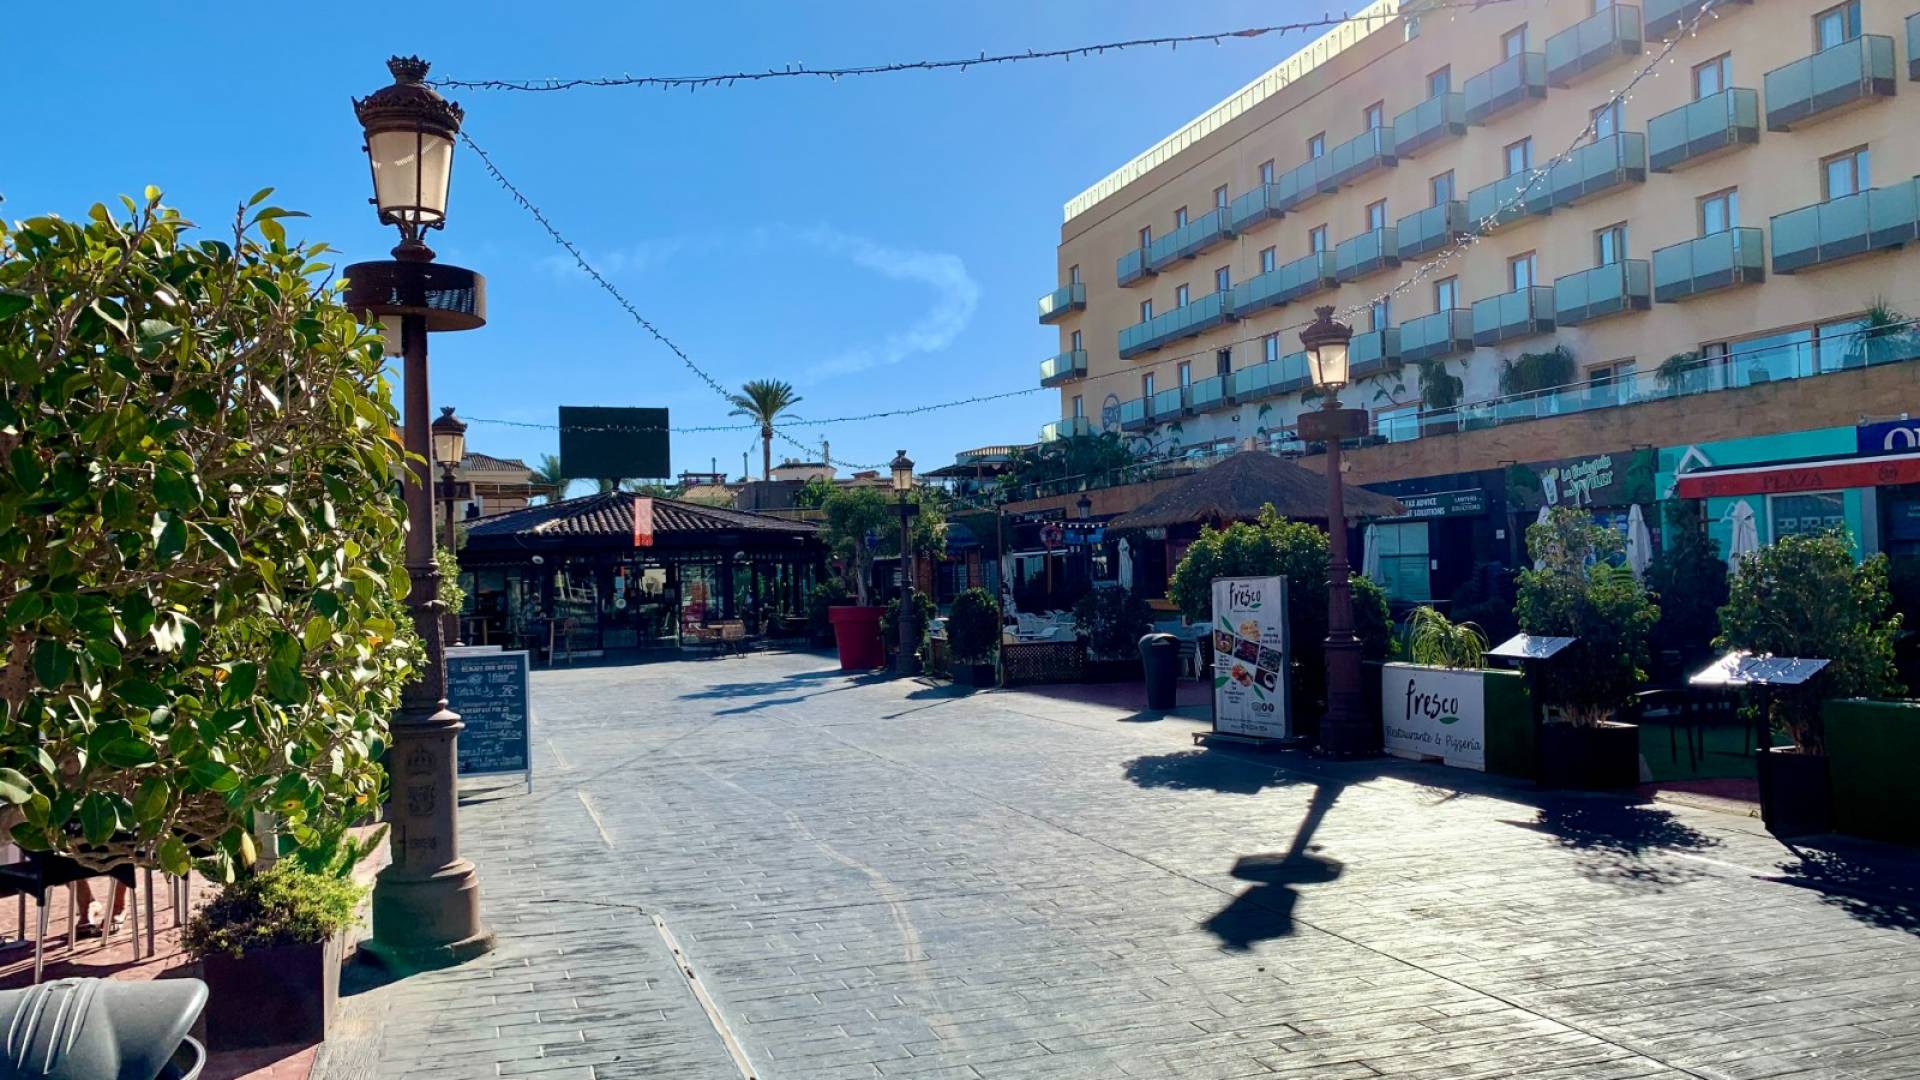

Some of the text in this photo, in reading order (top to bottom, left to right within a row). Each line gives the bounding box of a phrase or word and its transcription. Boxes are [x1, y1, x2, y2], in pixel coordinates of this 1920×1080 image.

[1763, 472, 1824, 490] PLAZA
[1414, 506, 1446, 517] SOLUTIONS
[1416, 498, 1437, 507] ADVICE
[1230, 582, 1261, 609] fresco
[1405, 679, 1459, 720] fresco
[1385, 725, 1433, 744] Restaurante
[1446, 735, 1481, 753] Pizzeria
